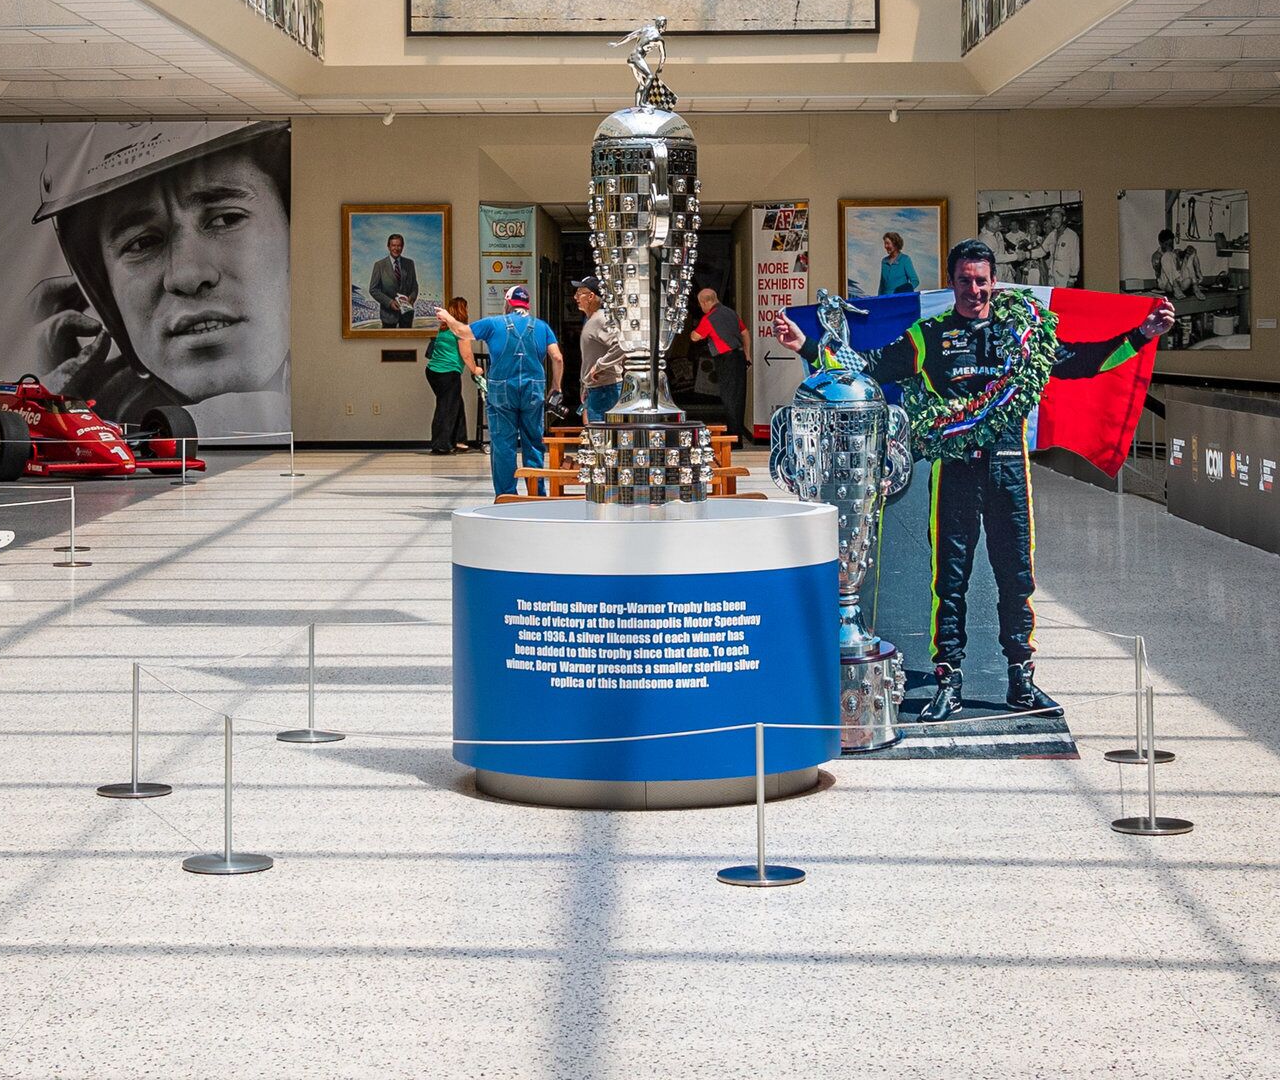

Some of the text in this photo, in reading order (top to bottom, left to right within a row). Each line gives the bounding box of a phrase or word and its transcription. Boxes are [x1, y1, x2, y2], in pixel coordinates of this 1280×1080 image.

[492, 221, 526, 238] ICON
[758, 263, 789, 274] MORE
[758, 278, 805, 290] EXHIBITS
[758, 294, 792, 306] IN THE
[517, 599, 746, 615] The sterling silver Borg-Warner Trophy has been
[504, 614, 761, 629] symbolic of victory at the Indianapolis Motor Speedway
[518, 629, 745, 644] since 1936. A silver likeness of each winner has
[514, 643, 749, 660] been added to this trophy since that date. To each
[505, 658, 760, 674] winner, Borg Warner presents a smaller sterling silver
[551, 676, 709, 689] replica of this handsome award.
